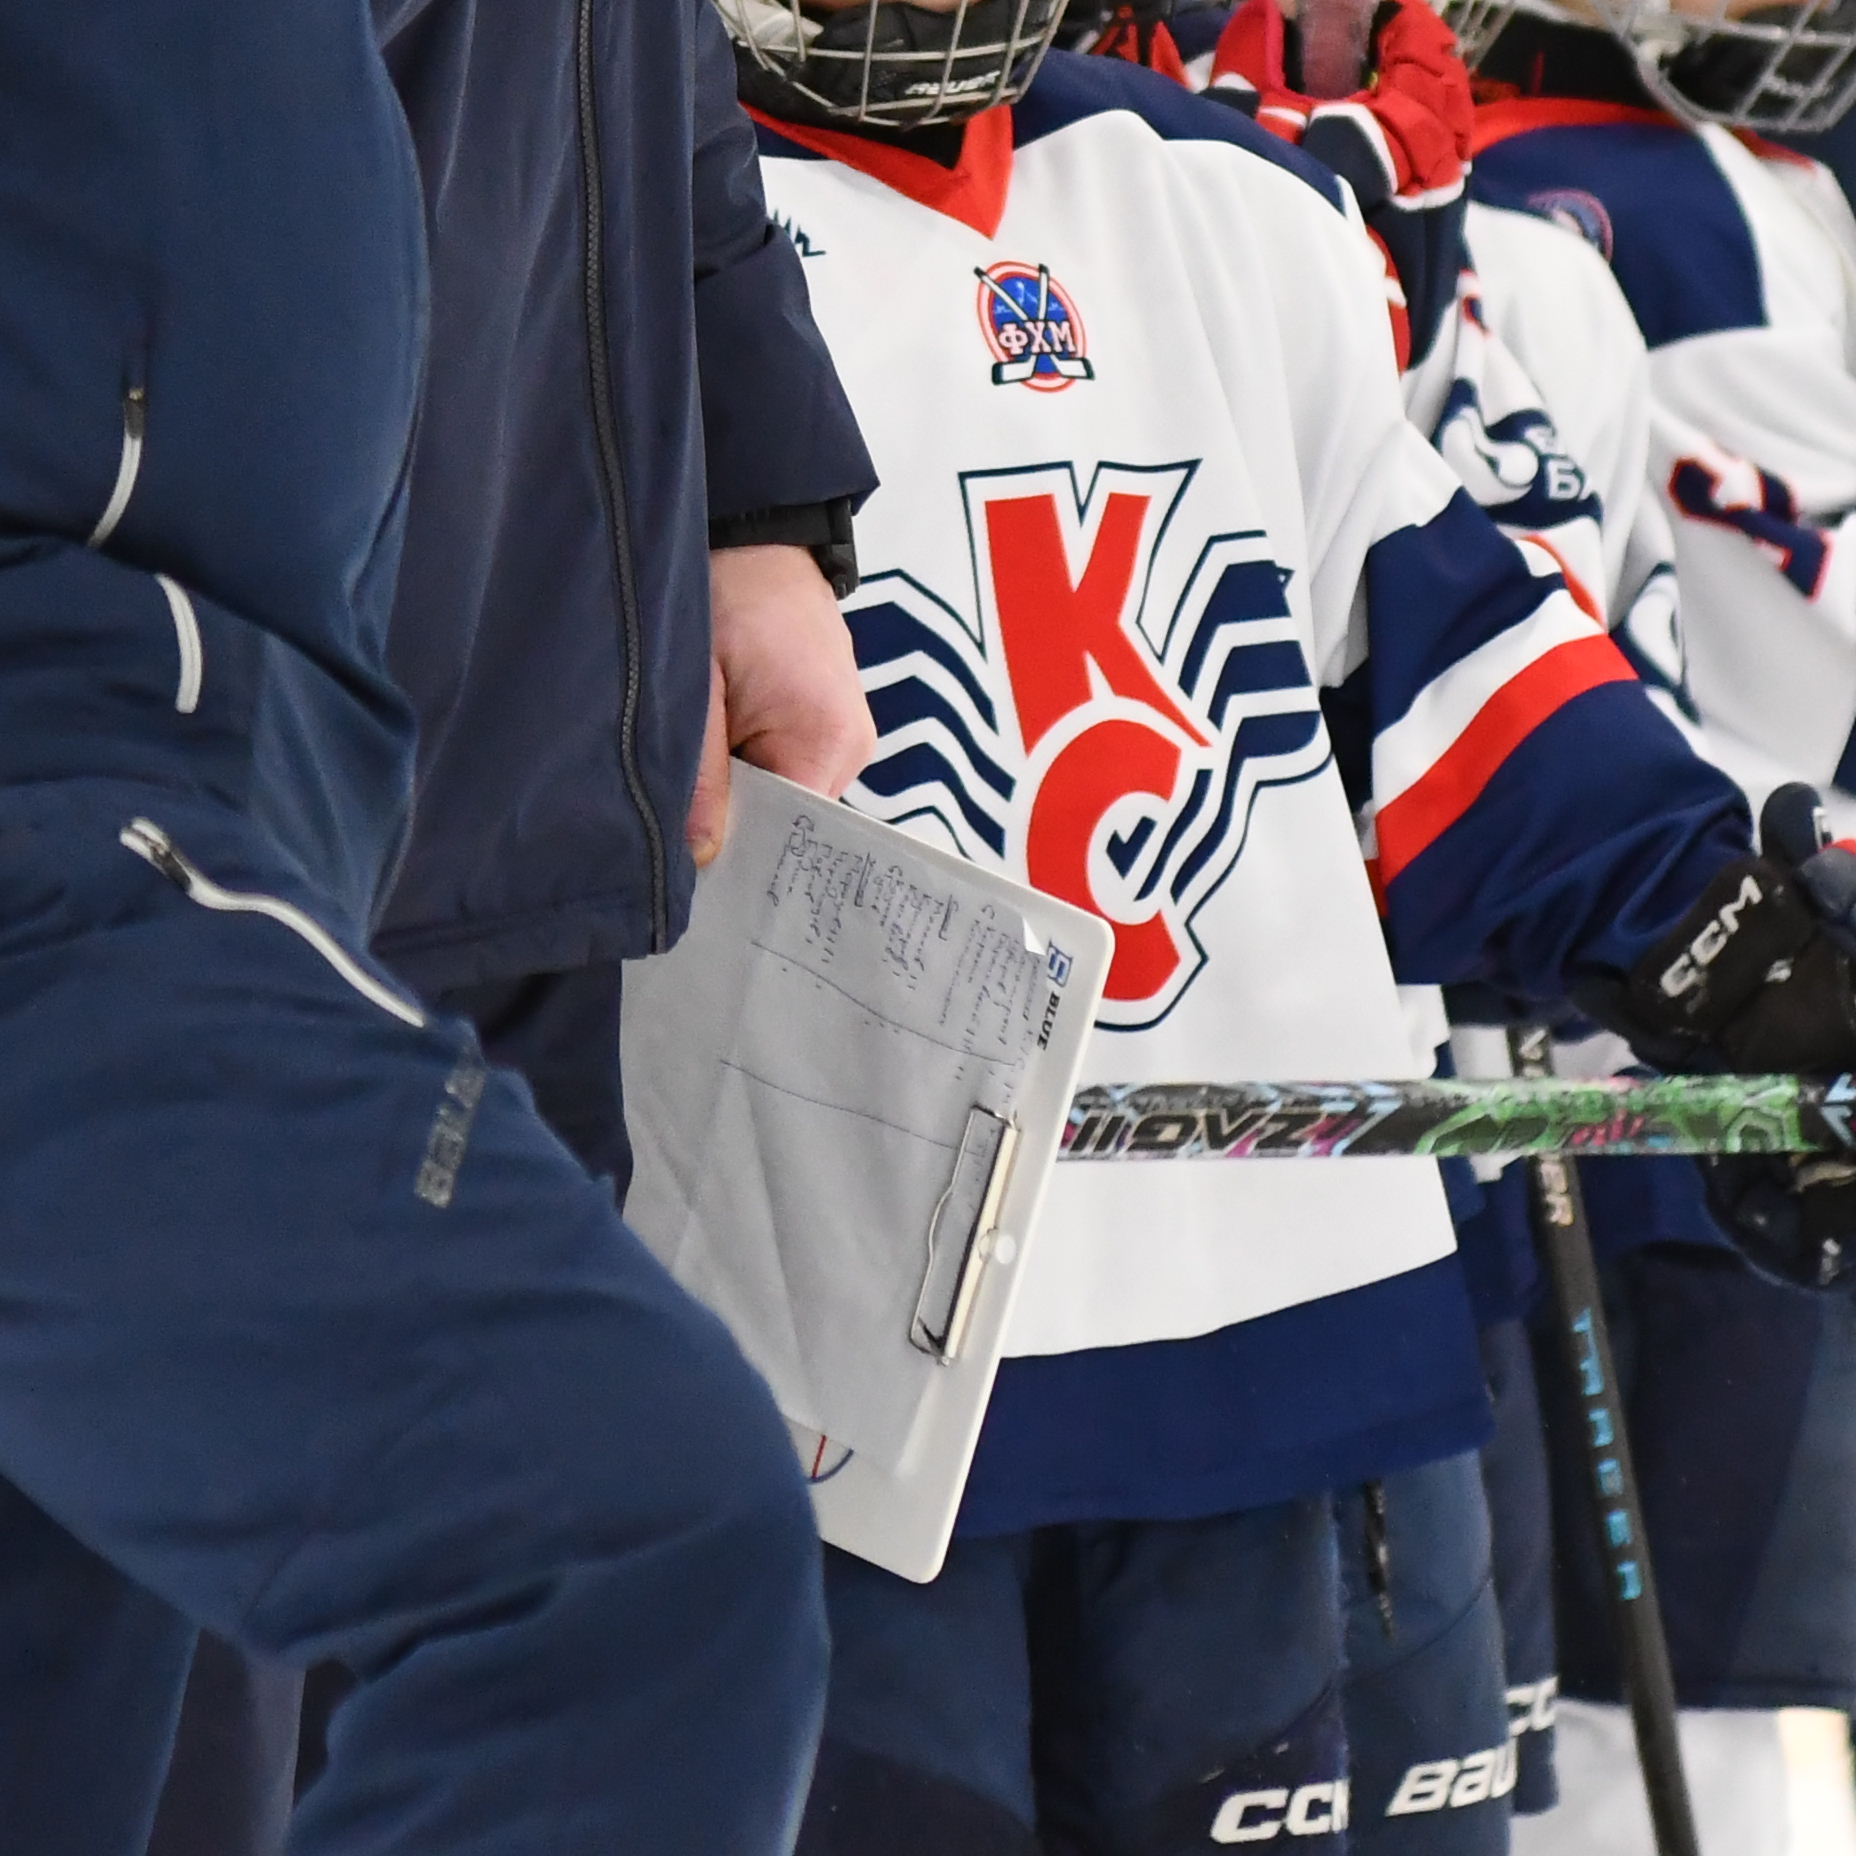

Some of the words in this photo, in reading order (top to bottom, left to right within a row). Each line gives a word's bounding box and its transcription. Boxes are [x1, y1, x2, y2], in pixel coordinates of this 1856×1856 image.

[998, 320, 1077, 356] ФХМ
[1659, 875, 1763, 998] CCM
[1036, 991, 1061, 1052] BLUE
